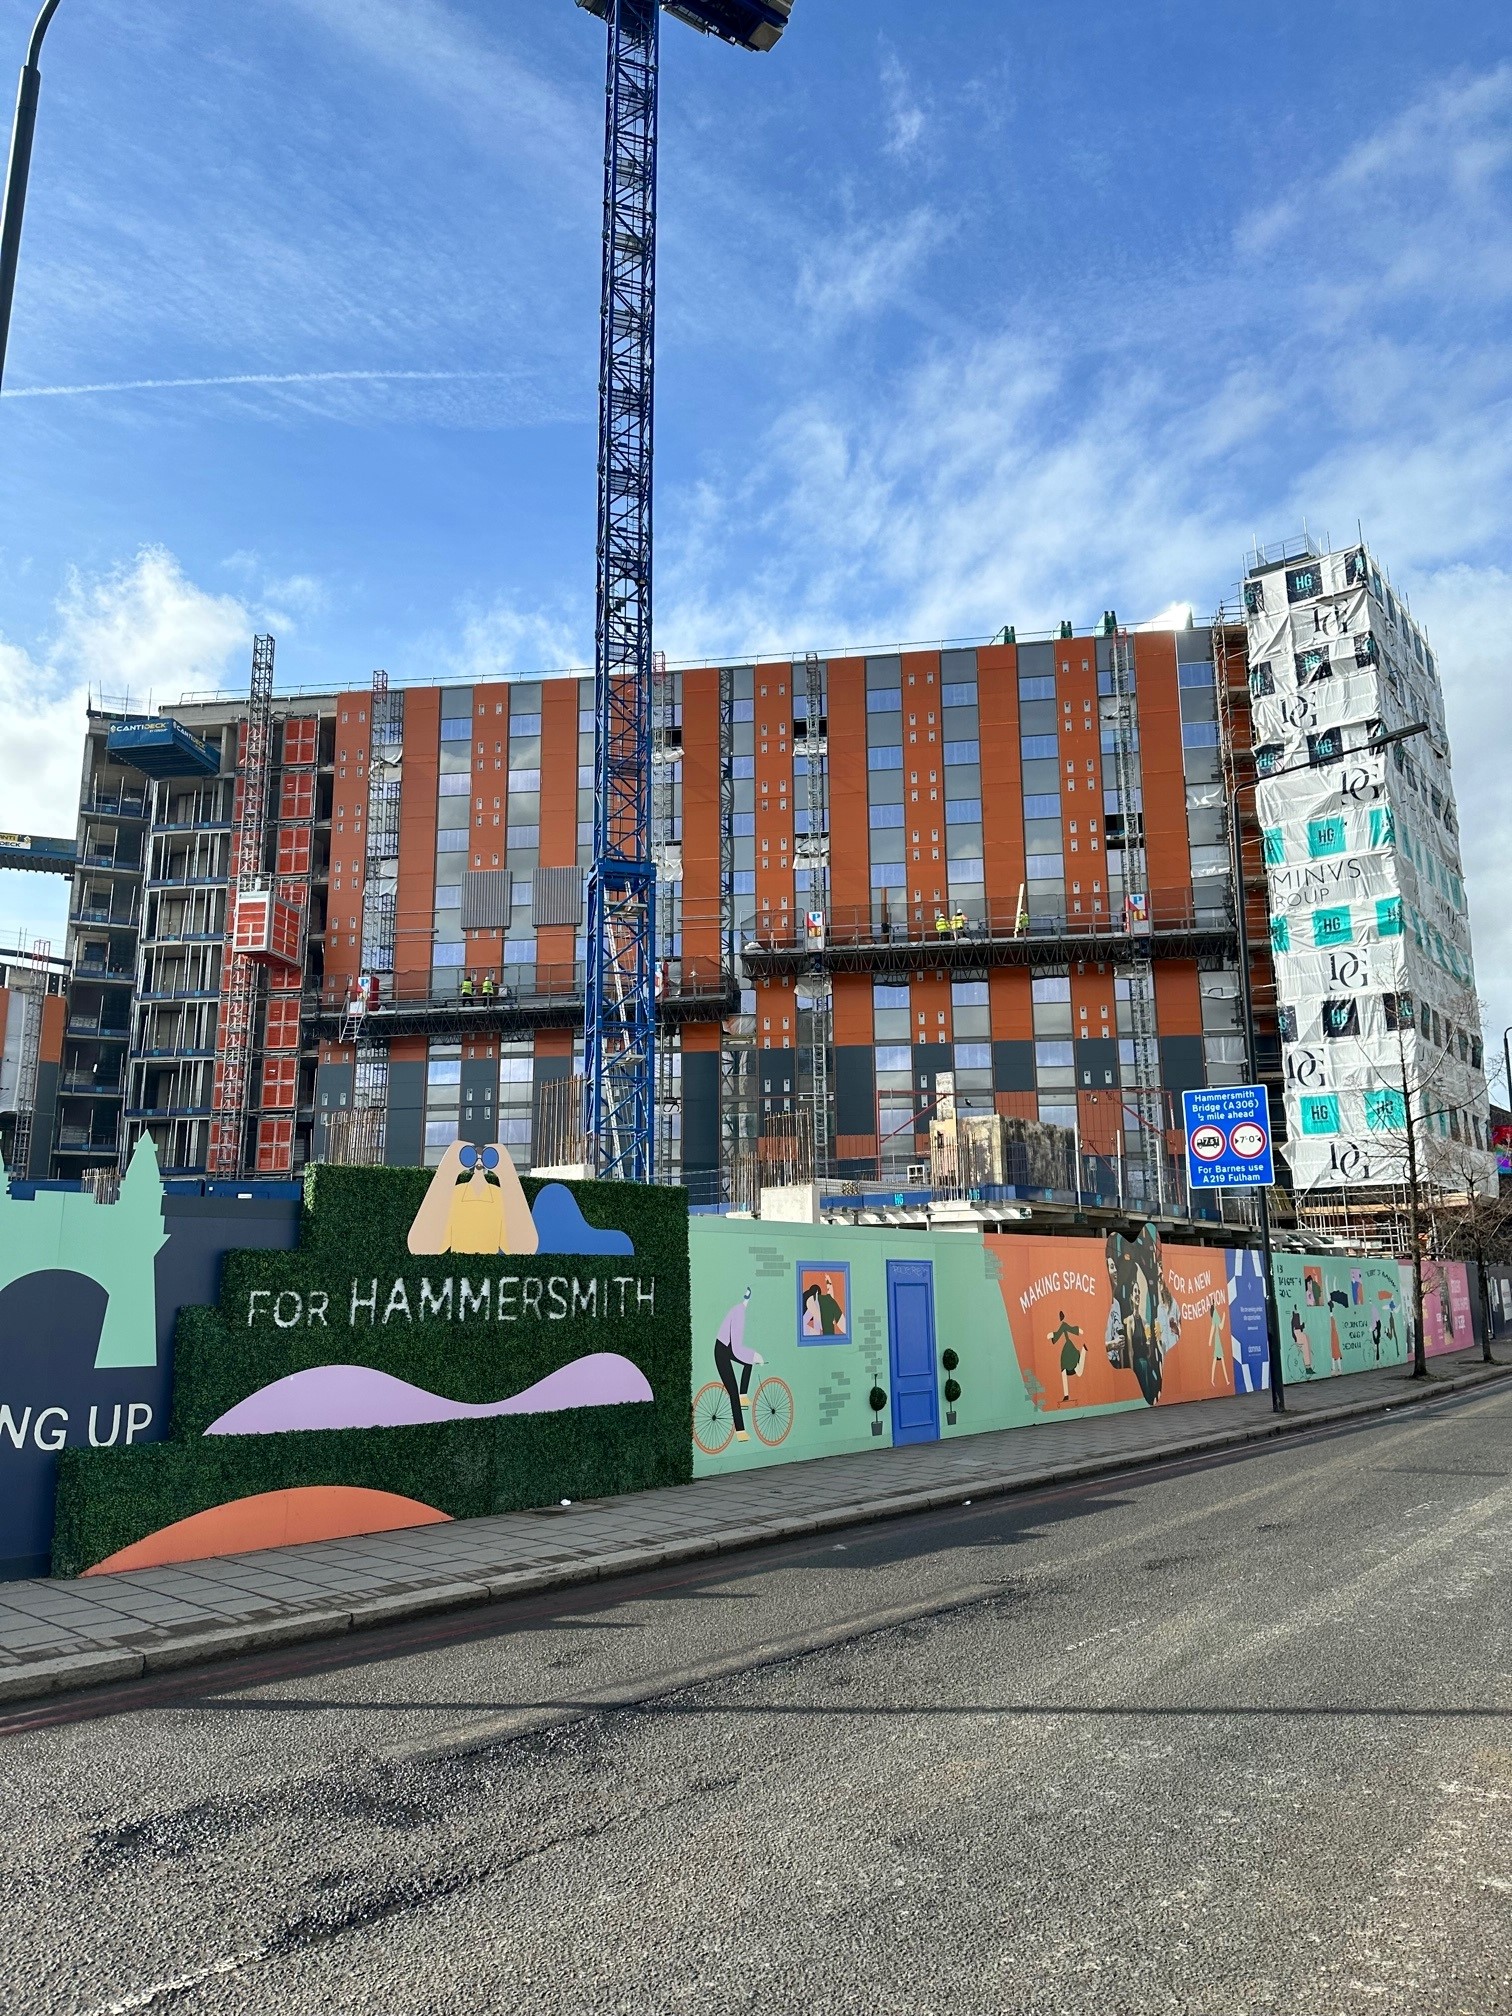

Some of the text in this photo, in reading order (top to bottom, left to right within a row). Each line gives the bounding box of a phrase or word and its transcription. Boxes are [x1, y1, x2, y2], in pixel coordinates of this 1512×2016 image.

[1296, 573, 1312, 590] HG
[116, 722, 167, 732] CANTIDECK
[1318, 828, 1336, 844] HG
[1272, 858, 1361, 893] MINVS
[1275, 888, 1330, 909] ROUP
[1324, 917, 1341, 934] HG
[1194, 1091, 1254, 1102] Hammersmith
[1192, 1099, 1259, 1112] Bridge (A306)
[1311, 1105, 1328, 1120] HG
[1207, 1112, 1225, 1120] mile
[1228, 1109, 1254, 1118] ahead
[1198, 1166, 1212, 1174] For
[1216, 1165, 1246, 1173] Barnes
[1203, 1174, 1260, 1183] A219 Fulham
[1168, 1269, 1212, 1294] FOR A NEW
[1020, 1270, 1096, 1314] MAKING SPACE
[248, 1276, 655, 1328] FOR HAMMERSMITH
[1182, 1288, 1226, 1320] GENERATION
[88, 1403, 153, 1447] UP
